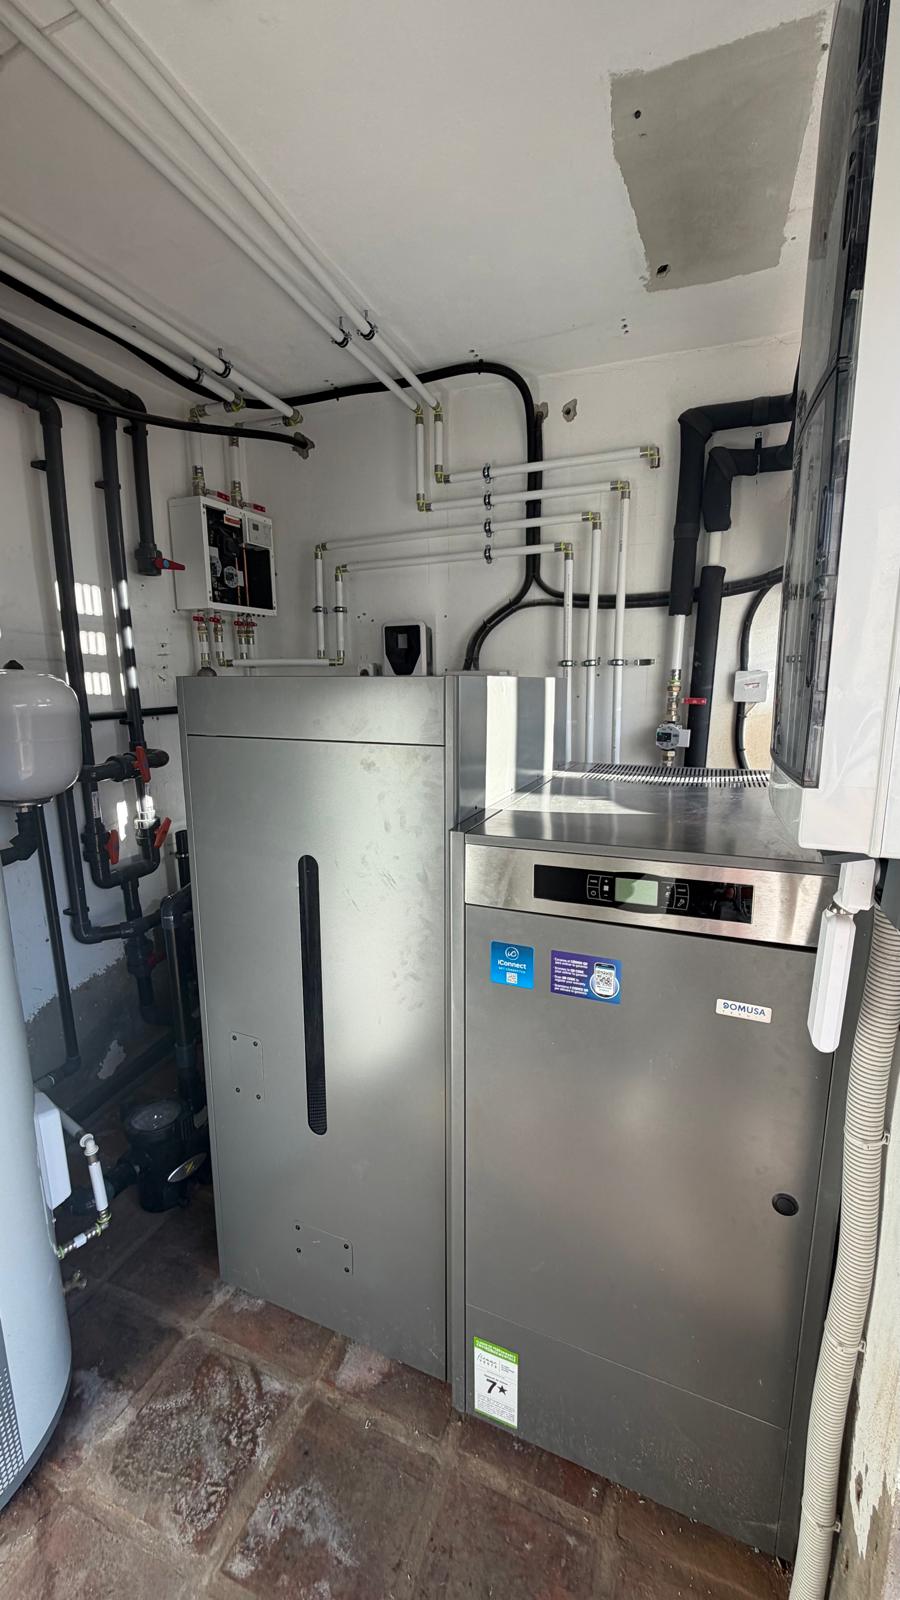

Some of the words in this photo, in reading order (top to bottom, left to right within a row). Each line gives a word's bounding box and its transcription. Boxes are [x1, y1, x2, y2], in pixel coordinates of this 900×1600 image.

[497, 959, 527, 970] iConnect
[722, 1001, 766, 1017] DOMUSA
[486, 1378, 497, 1394] 7
